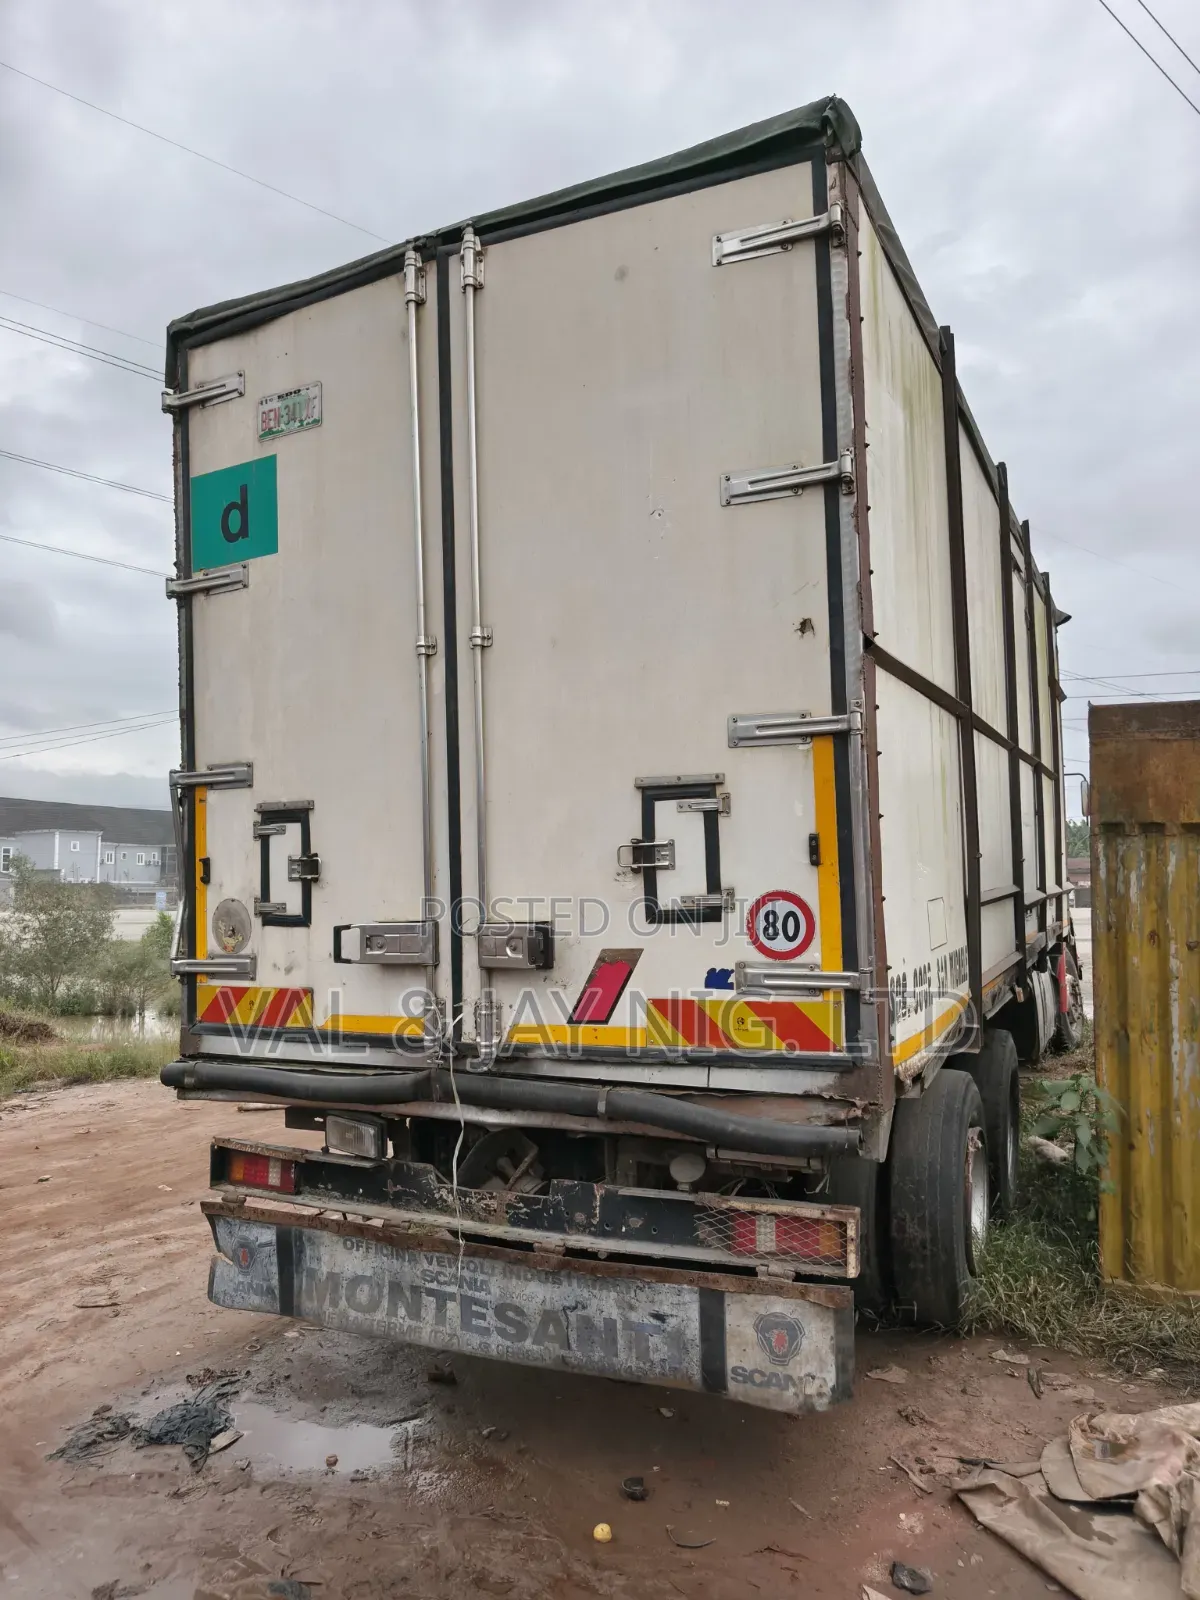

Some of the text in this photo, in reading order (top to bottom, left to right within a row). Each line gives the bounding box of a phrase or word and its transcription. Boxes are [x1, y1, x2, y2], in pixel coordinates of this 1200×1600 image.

[220, 484, 250, 544] d
[762, 909, 801, 943] 80
[420, 1267, 492, 1296] SCANIA
